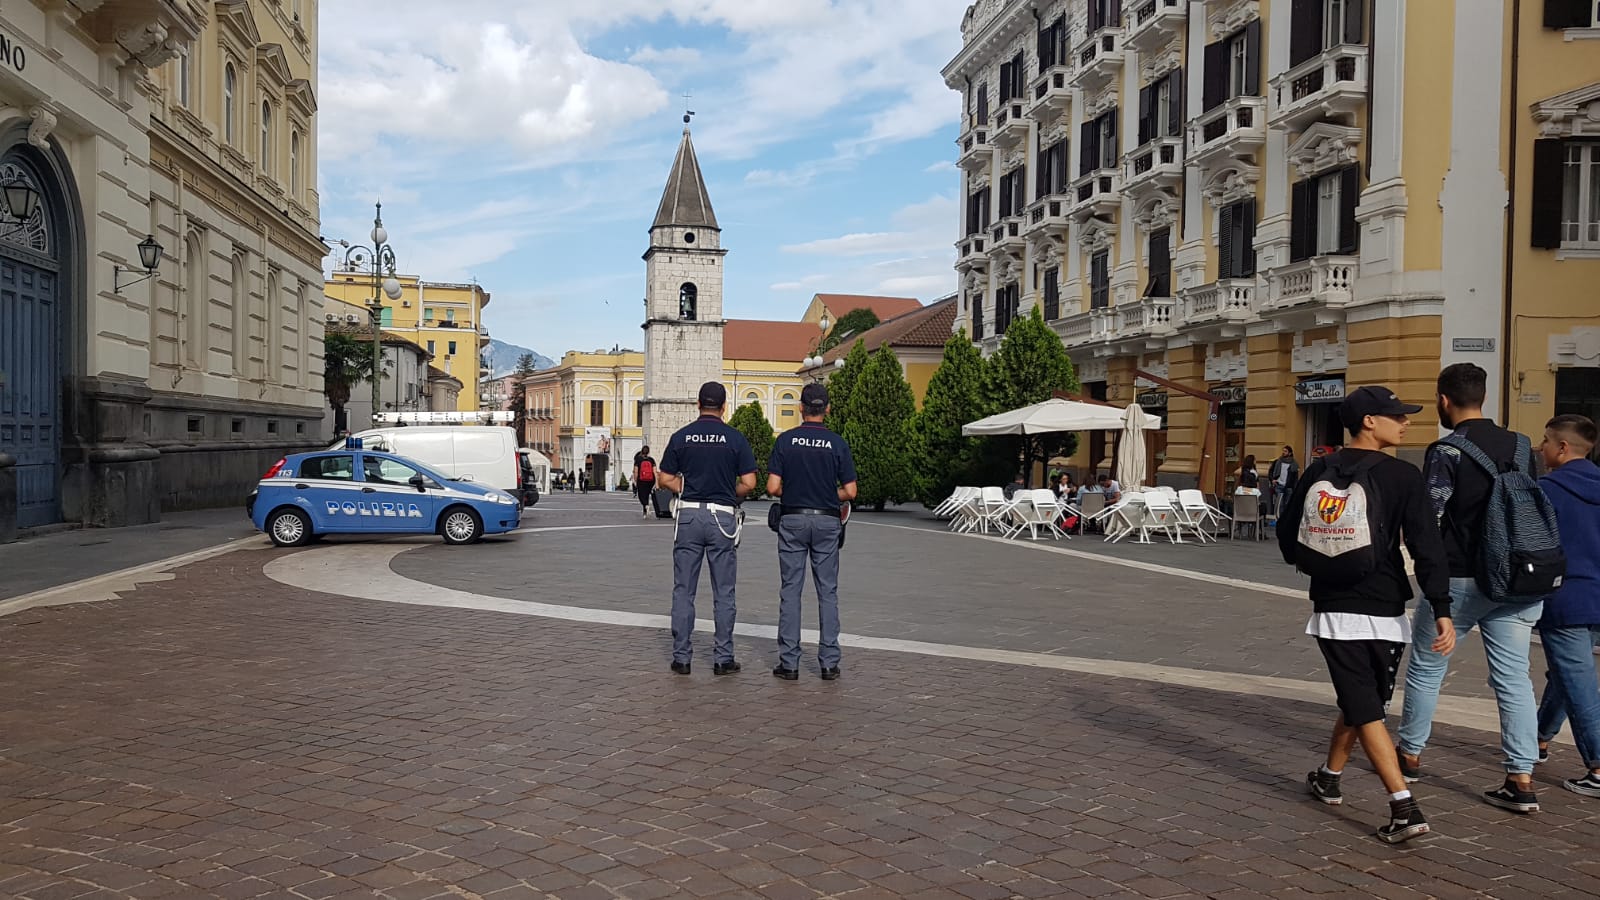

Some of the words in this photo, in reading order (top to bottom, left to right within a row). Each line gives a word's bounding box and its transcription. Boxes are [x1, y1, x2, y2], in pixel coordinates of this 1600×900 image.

[0, 34, 25, 72] NO
[685, 434, 727, 443] POLIZIA
[791, 437, 833, 449] POLIZIA
[278, 468, 292, 477] 113
[326, 500, 423, 518] POLIZIA
[1308, 525, 1355, 535] BENEVENTO
